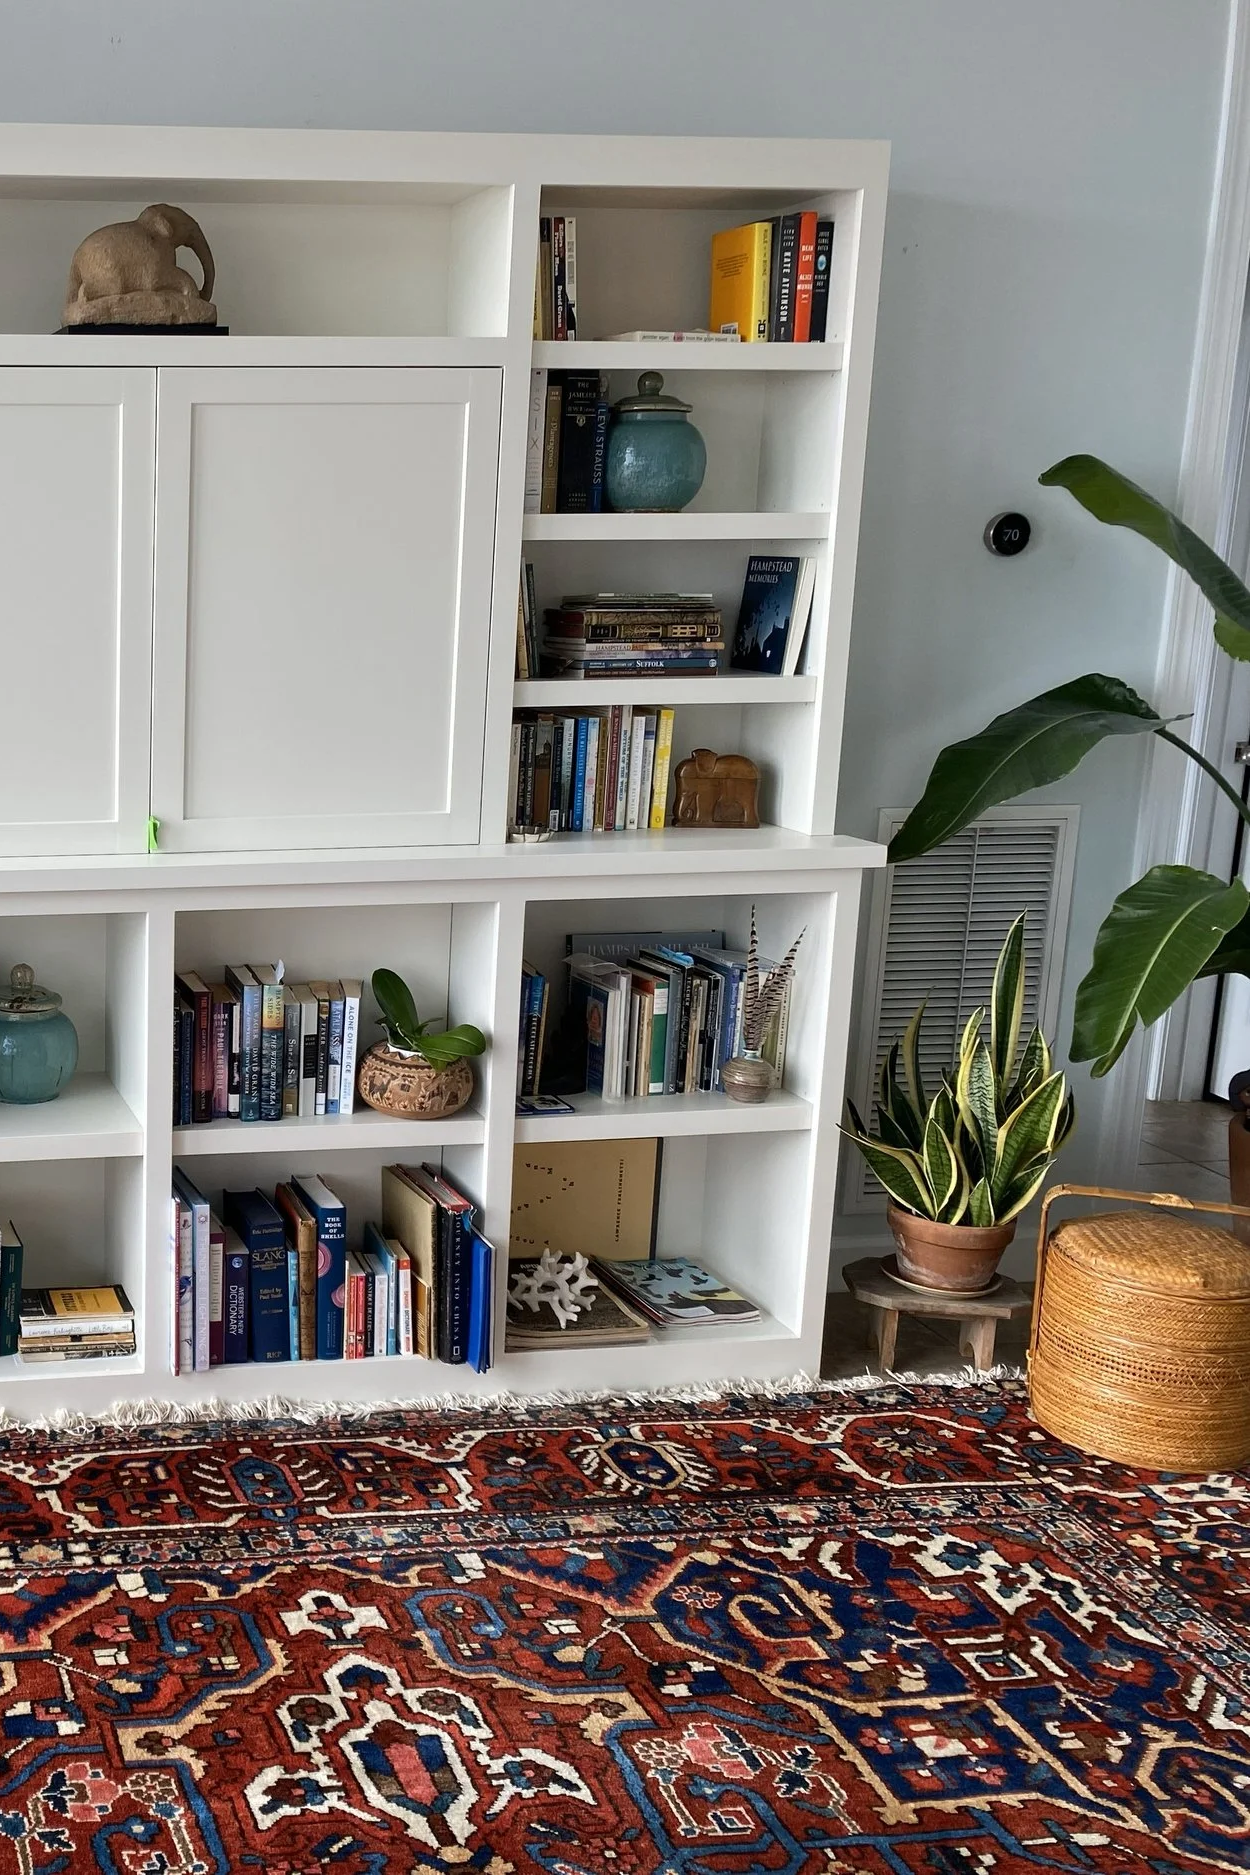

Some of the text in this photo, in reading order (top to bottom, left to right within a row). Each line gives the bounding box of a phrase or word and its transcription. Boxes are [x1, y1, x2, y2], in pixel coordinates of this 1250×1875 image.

[780, 251, 792, 322] KATE ATKINSON
[547, 422, 559, 468] Plantagenets
[593, 436, 604, 484] STRAUSS
[1004, 529, 1020, 541] 70
[748, 574, 779, 584] MEMORIES
[751, 560, 793, 573] HAMPSTEAD
[636, 659, 665, 668] SUFFOLK
[217, 1032, 225, 1090] PAUL THEROUX
[288, 1038, 296, 1084] Star Sea
[347, 1032, 354, 1044] ON
[614, 1158, 625, 1243] LAWRENCE FERLINGHETTI
[252, 1250, 286, 1262] SLANG
[454, 1216, 462, 1266] JOURNEY
[199, 1238, 208, 1350] THUNDER LIGHTNING
[229, 1285, 239, 1335] DICTIONARY
[404, 1309, 412, 1335] DICTIONARY
[453, 1306, 461, 1341] CHINA
